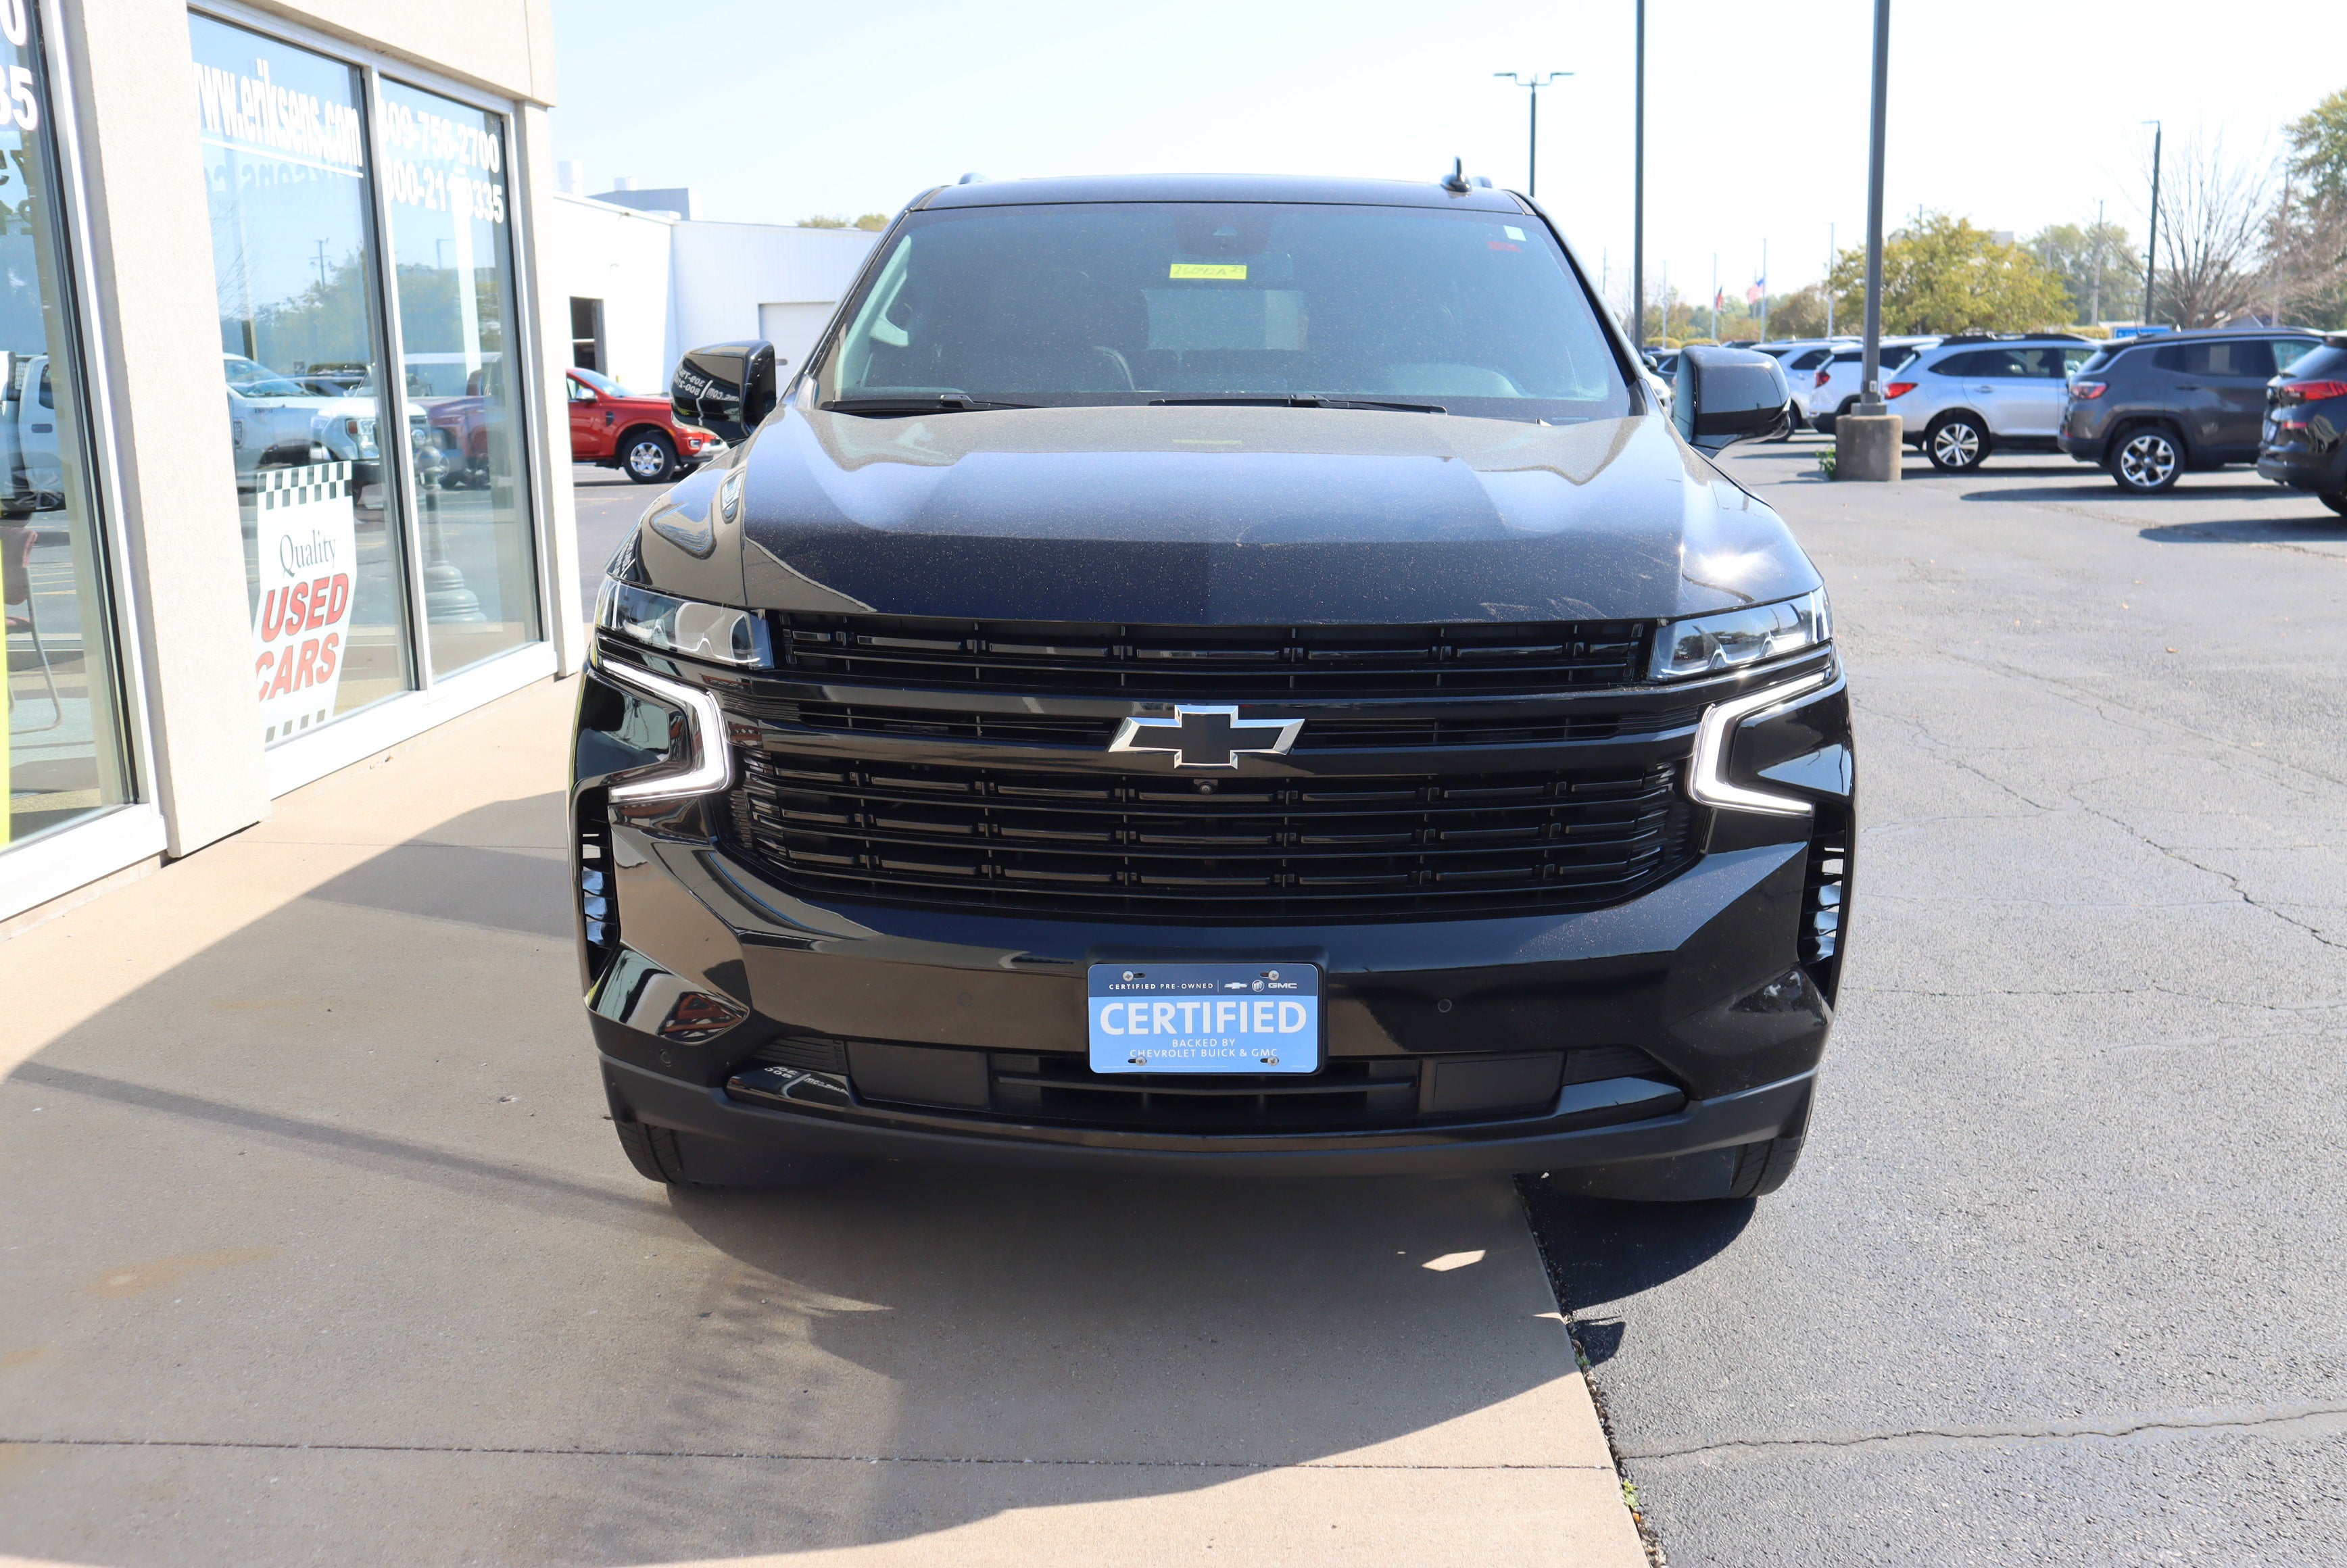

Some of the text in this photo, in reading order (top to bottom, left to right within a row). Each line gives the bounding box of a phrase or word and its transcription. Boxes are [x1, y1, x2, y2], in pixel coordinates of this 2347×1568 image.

[192, 57, 363, 168] ww.eriksens.com
[279, 527, 336, 579] Quality
[261, 572, 349, 643] USED
[255, 632, 339, 702] CARS
[1100, 1001, 1307, 1035] CERTIFIED
[1172, 1038, 1236, 1048] BACKED BY
[1130, 1048, 1278, 1058] CHEVROLET BUICK & GMC
